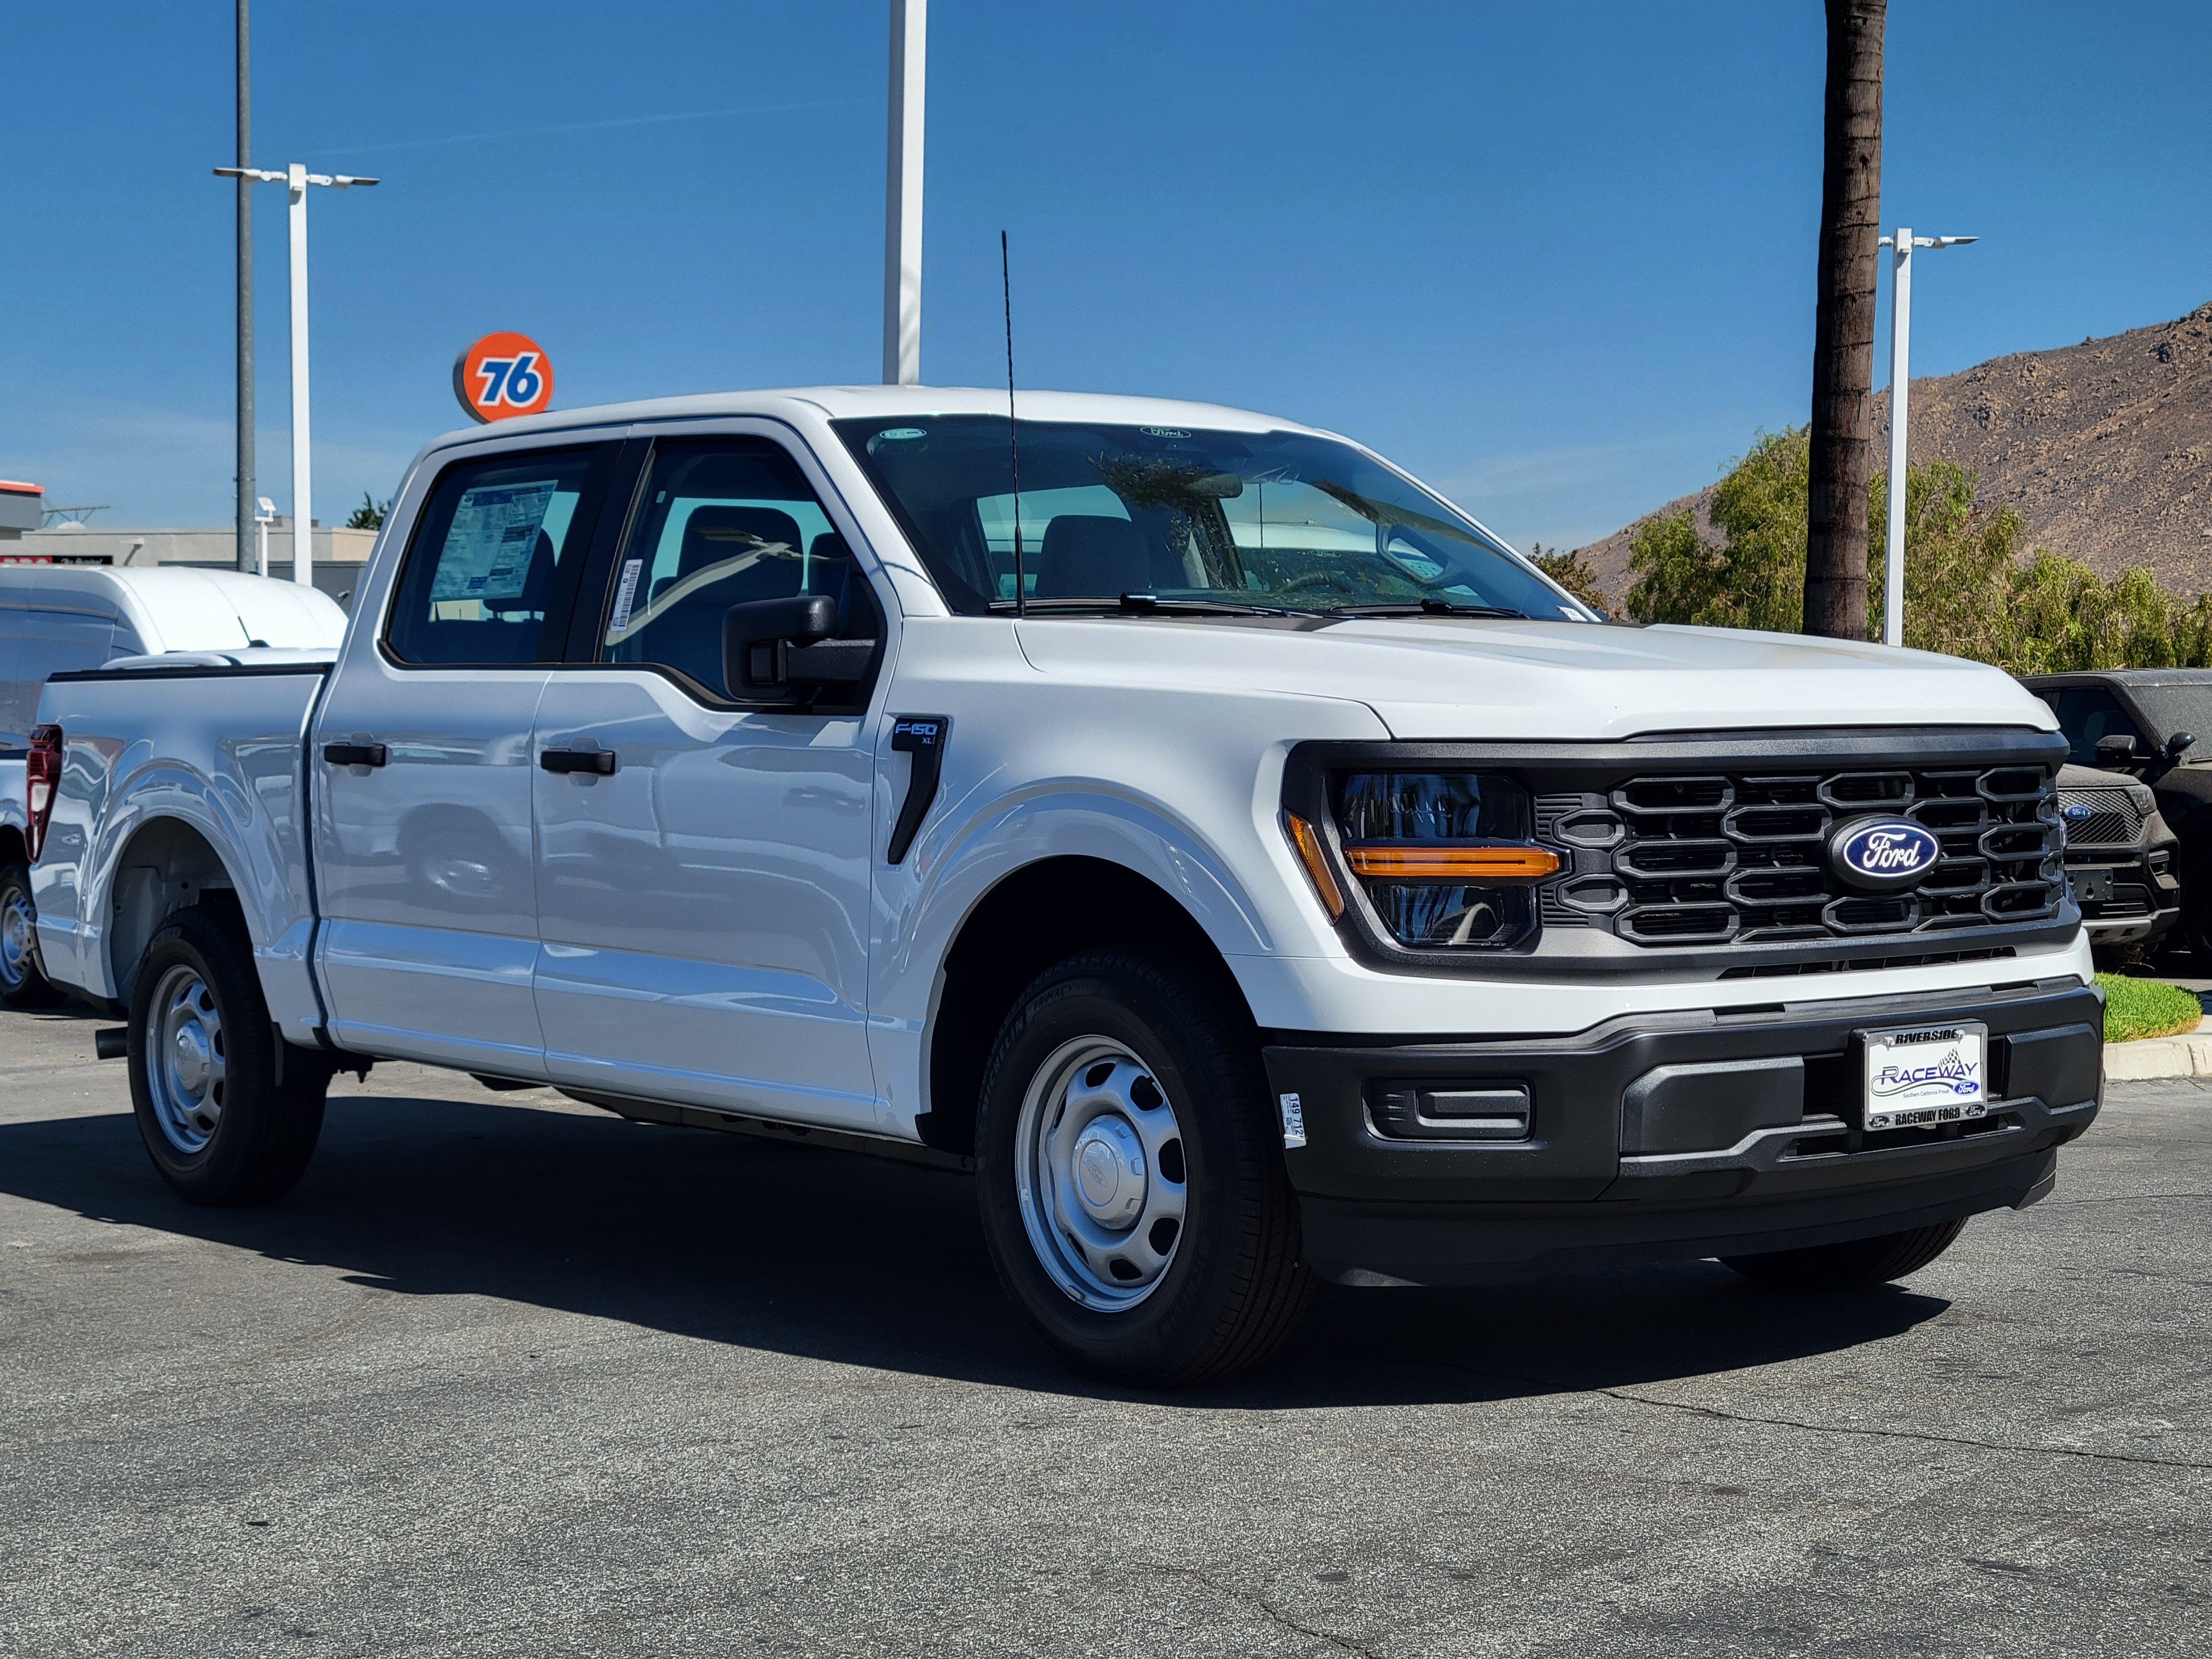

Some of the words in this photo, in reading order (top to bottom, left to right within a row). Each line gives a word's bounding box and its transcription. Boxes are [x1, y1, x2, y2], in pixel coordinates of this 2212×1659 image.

[476, 352, 543, 407] 76
[895, 723, 938, 735] F-150
[1863, 832, 1921, 868] Ford
[1895, 1029, 1957, 1044] RIVERSIDE
[1880, 1062, 1978, 1085] RACEWAY
[1957, 1082, 1975, 1093] Ford
[1895, 1110, 1937, 1125] RACEWAY
[1938, 1108, 1960, 1120] FORD
